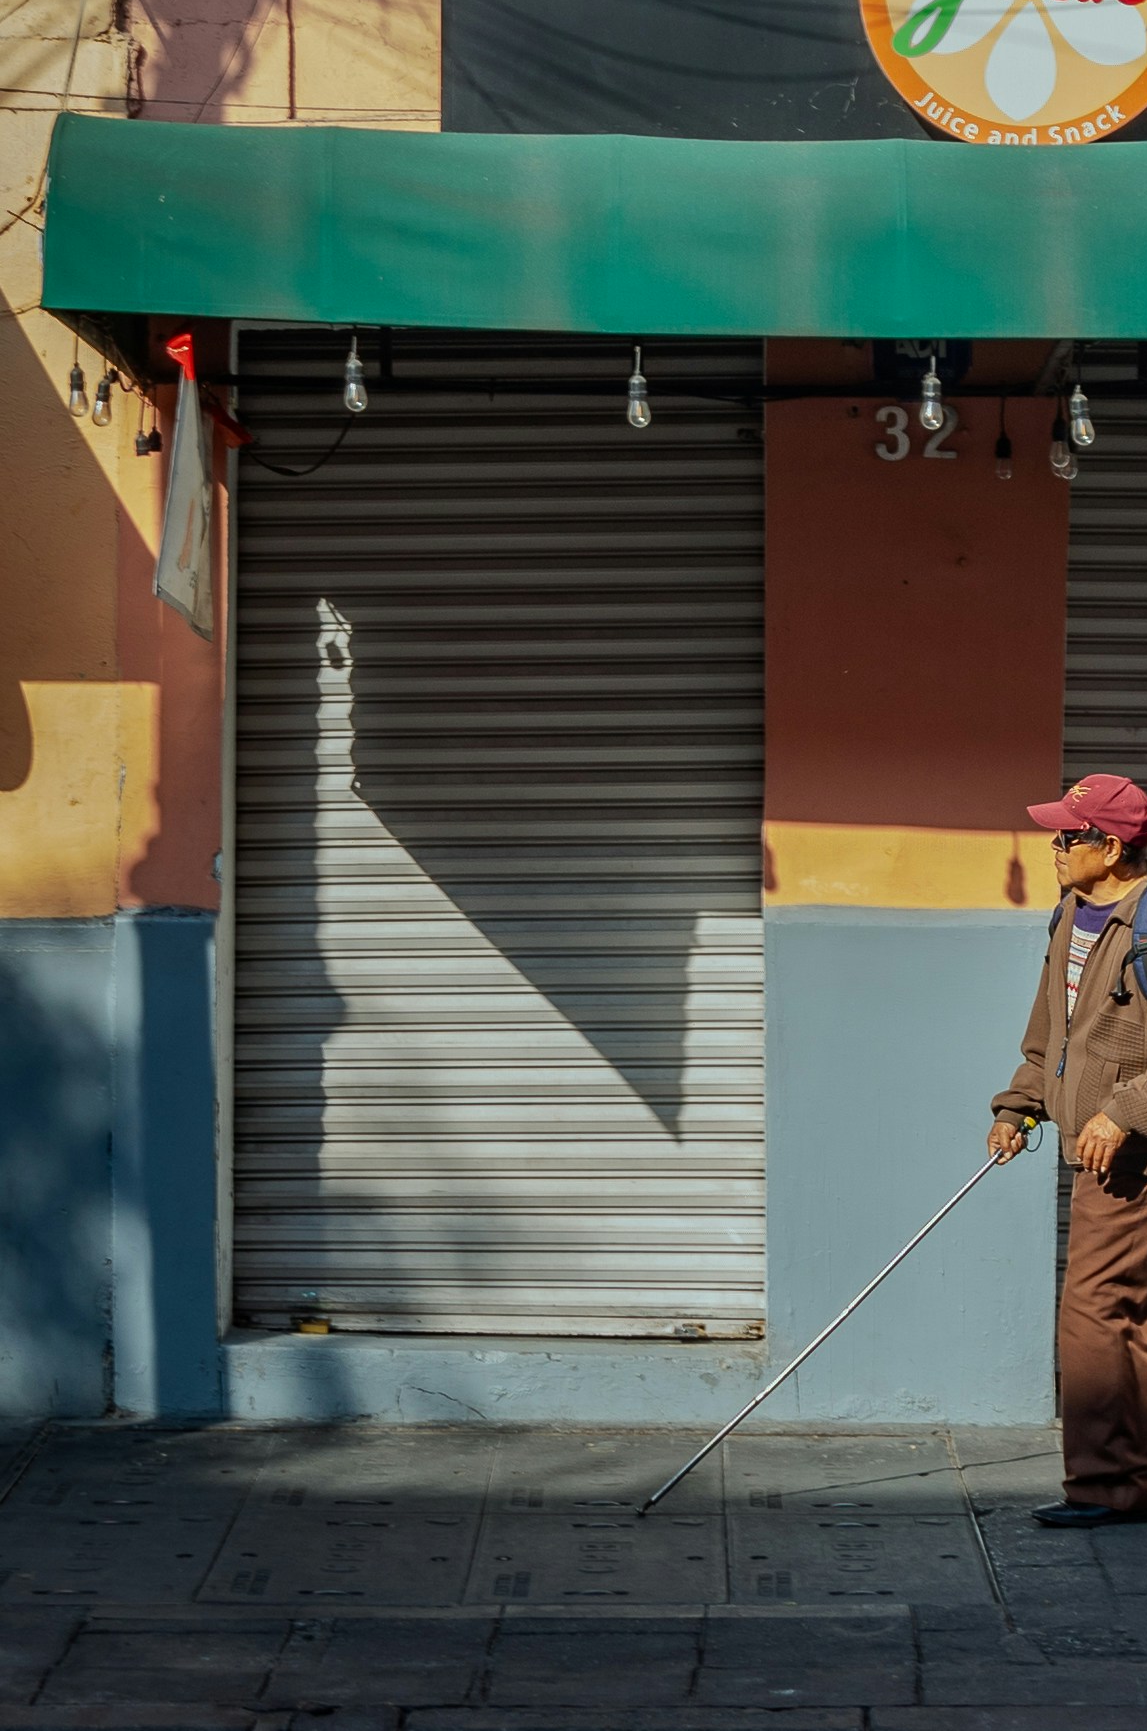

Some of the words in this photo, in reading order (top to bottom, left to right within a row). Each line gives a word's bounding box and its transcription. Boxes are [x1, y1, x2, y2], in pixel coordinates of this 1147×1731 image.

[914, 92, 979, 140] Juice
[986, 128, 1038, 146] and
[1048, 104, 1127, 146] Snack
[875, 405, 958, 461] 32
